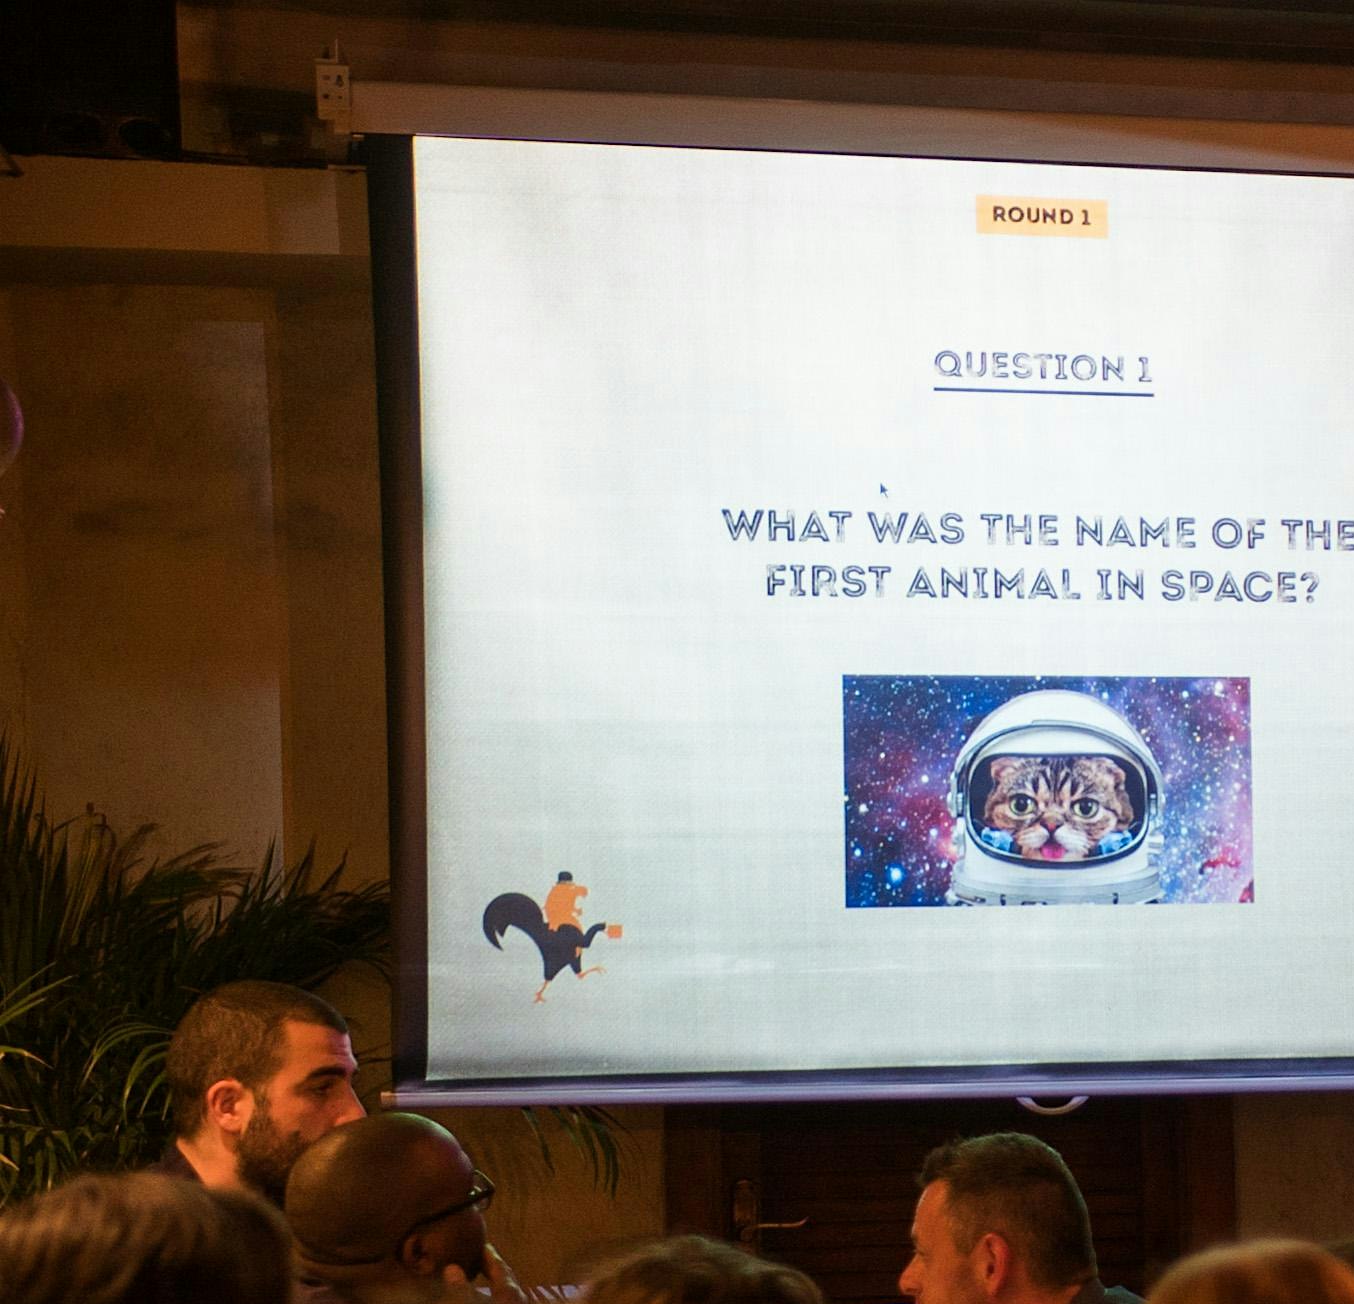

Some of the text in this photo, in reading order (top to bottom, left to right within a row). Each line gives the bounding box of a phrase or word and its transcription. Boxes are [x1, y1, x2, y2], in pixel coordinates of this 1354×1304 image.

[992, 205, 1092, 226] ROUND 1
[934, 350, 1153, 383] QUESTION 1
[721, 508, 853, 543] WHAT
[866, 510, 966, 545] WAS
[980, 513, 1060, 546] THE
[1075, 515, 1197, 549] NAME
[1211, 517, 1267, 550] OF
[765, 563, 1321, 605] FIRST ANIMAL IN SPACE?
